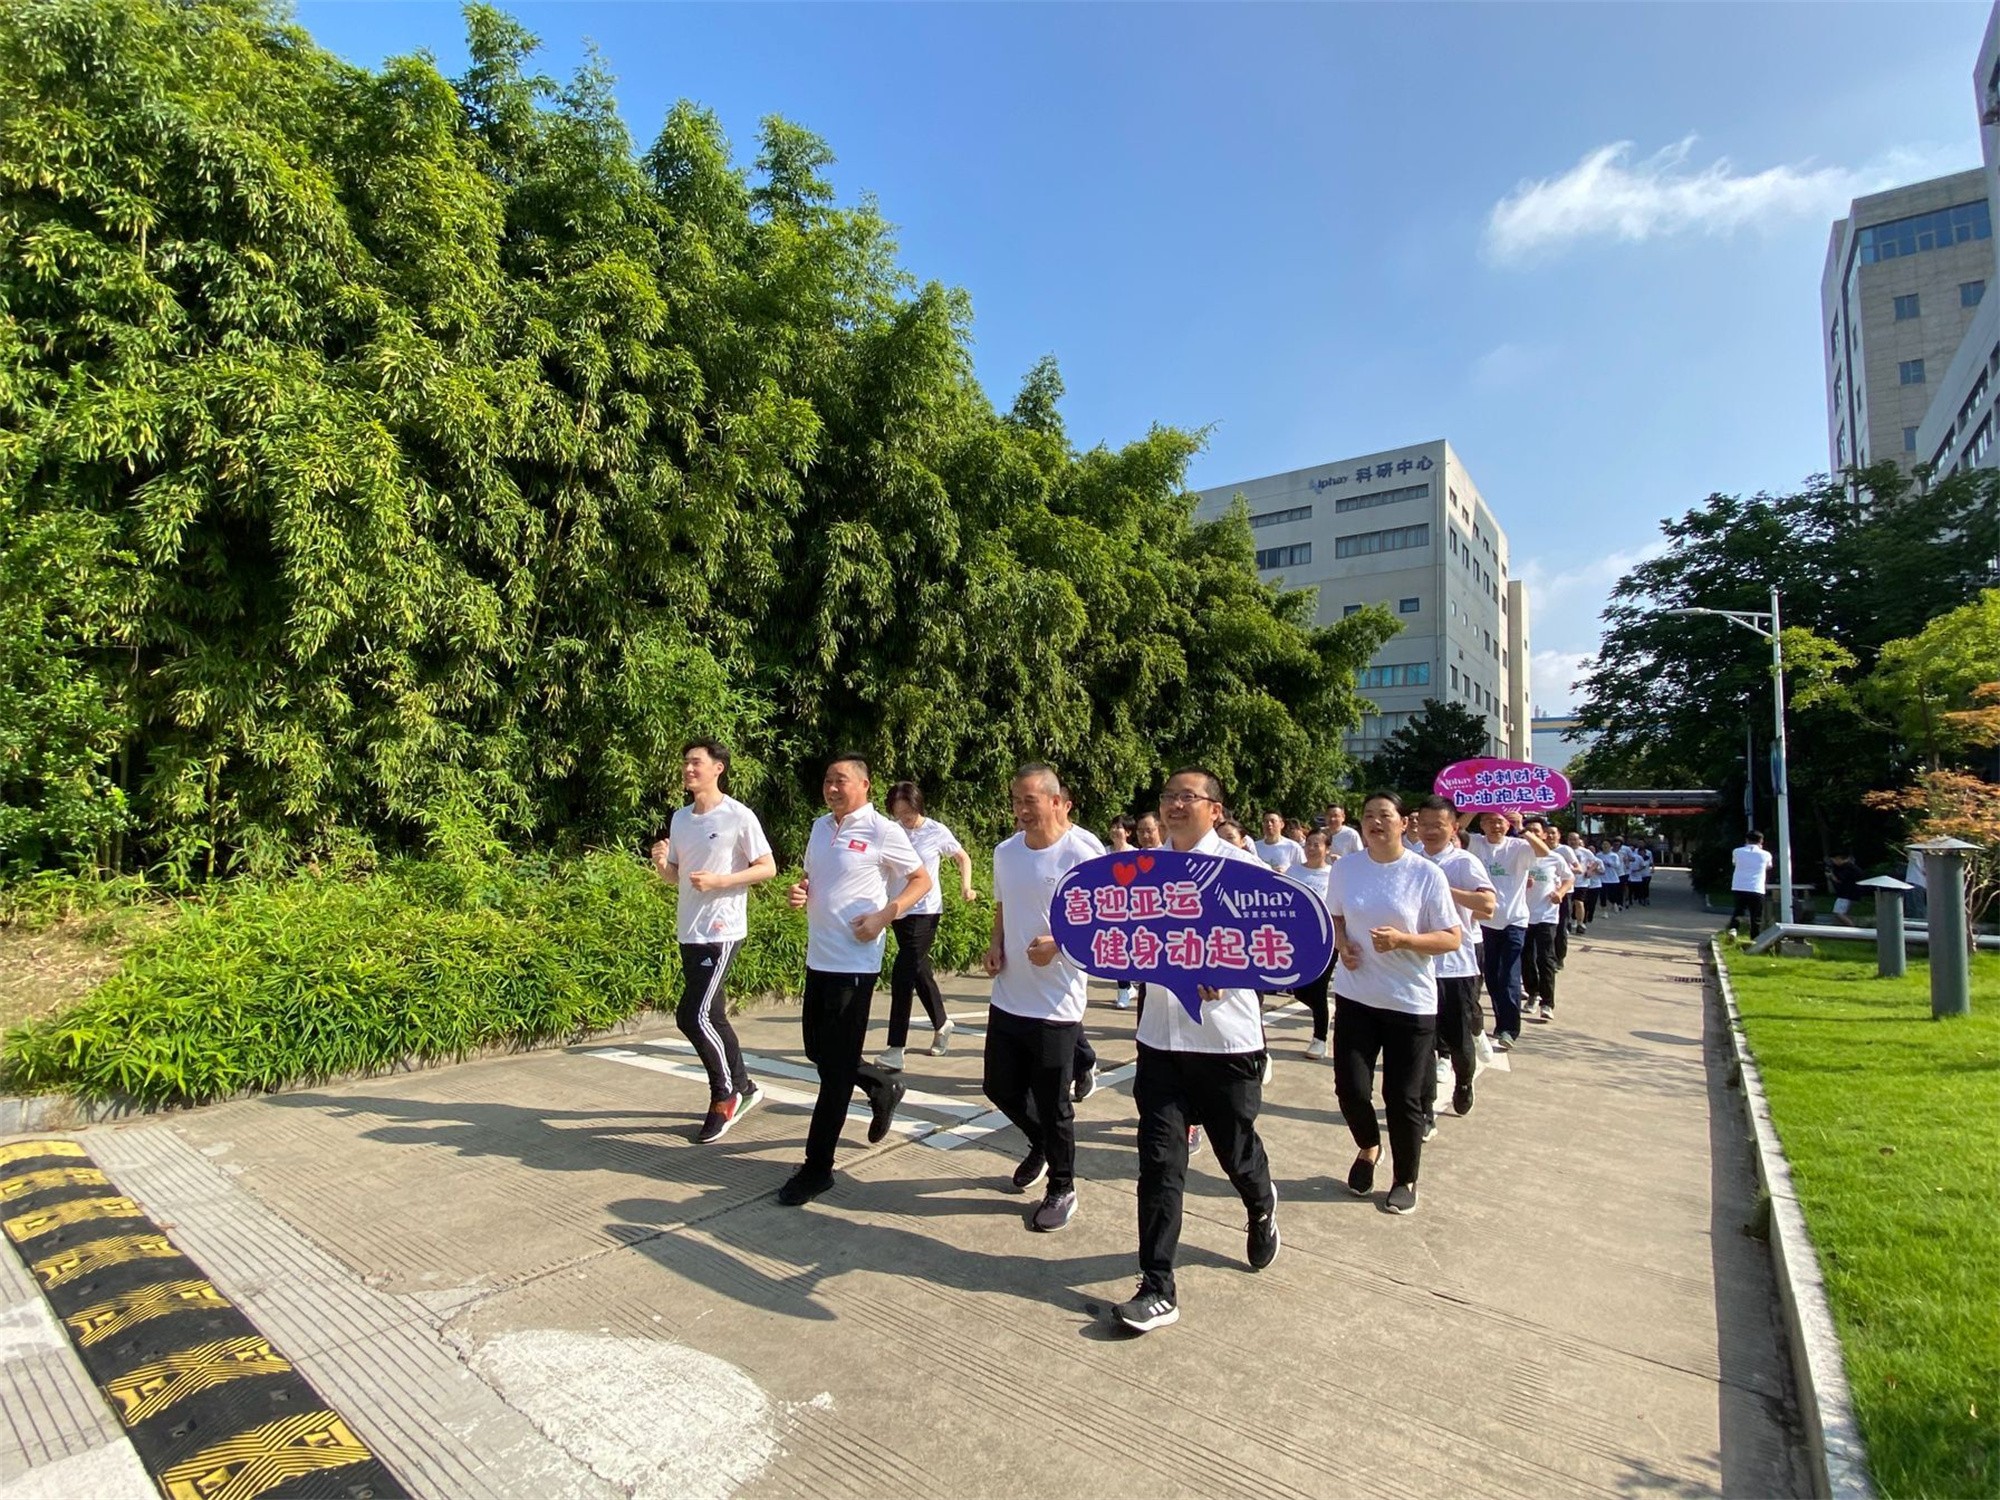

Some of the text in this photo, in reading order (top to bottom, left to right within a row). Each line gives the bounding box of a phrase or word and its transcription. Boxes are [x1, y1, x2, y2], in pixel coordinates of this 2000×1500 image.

[1356, 455, 1433, 483] 科研中心
[1475, 768, 1551, 786] 冲刺财年
[1454, 786, 1556, 806] 加油跑起来
[1064, 881, 1203, 925] 喜迎亚运
[1215, 884, 1295, 918] Alphay
[1091, 924, 1294, 970] 健身动起来
